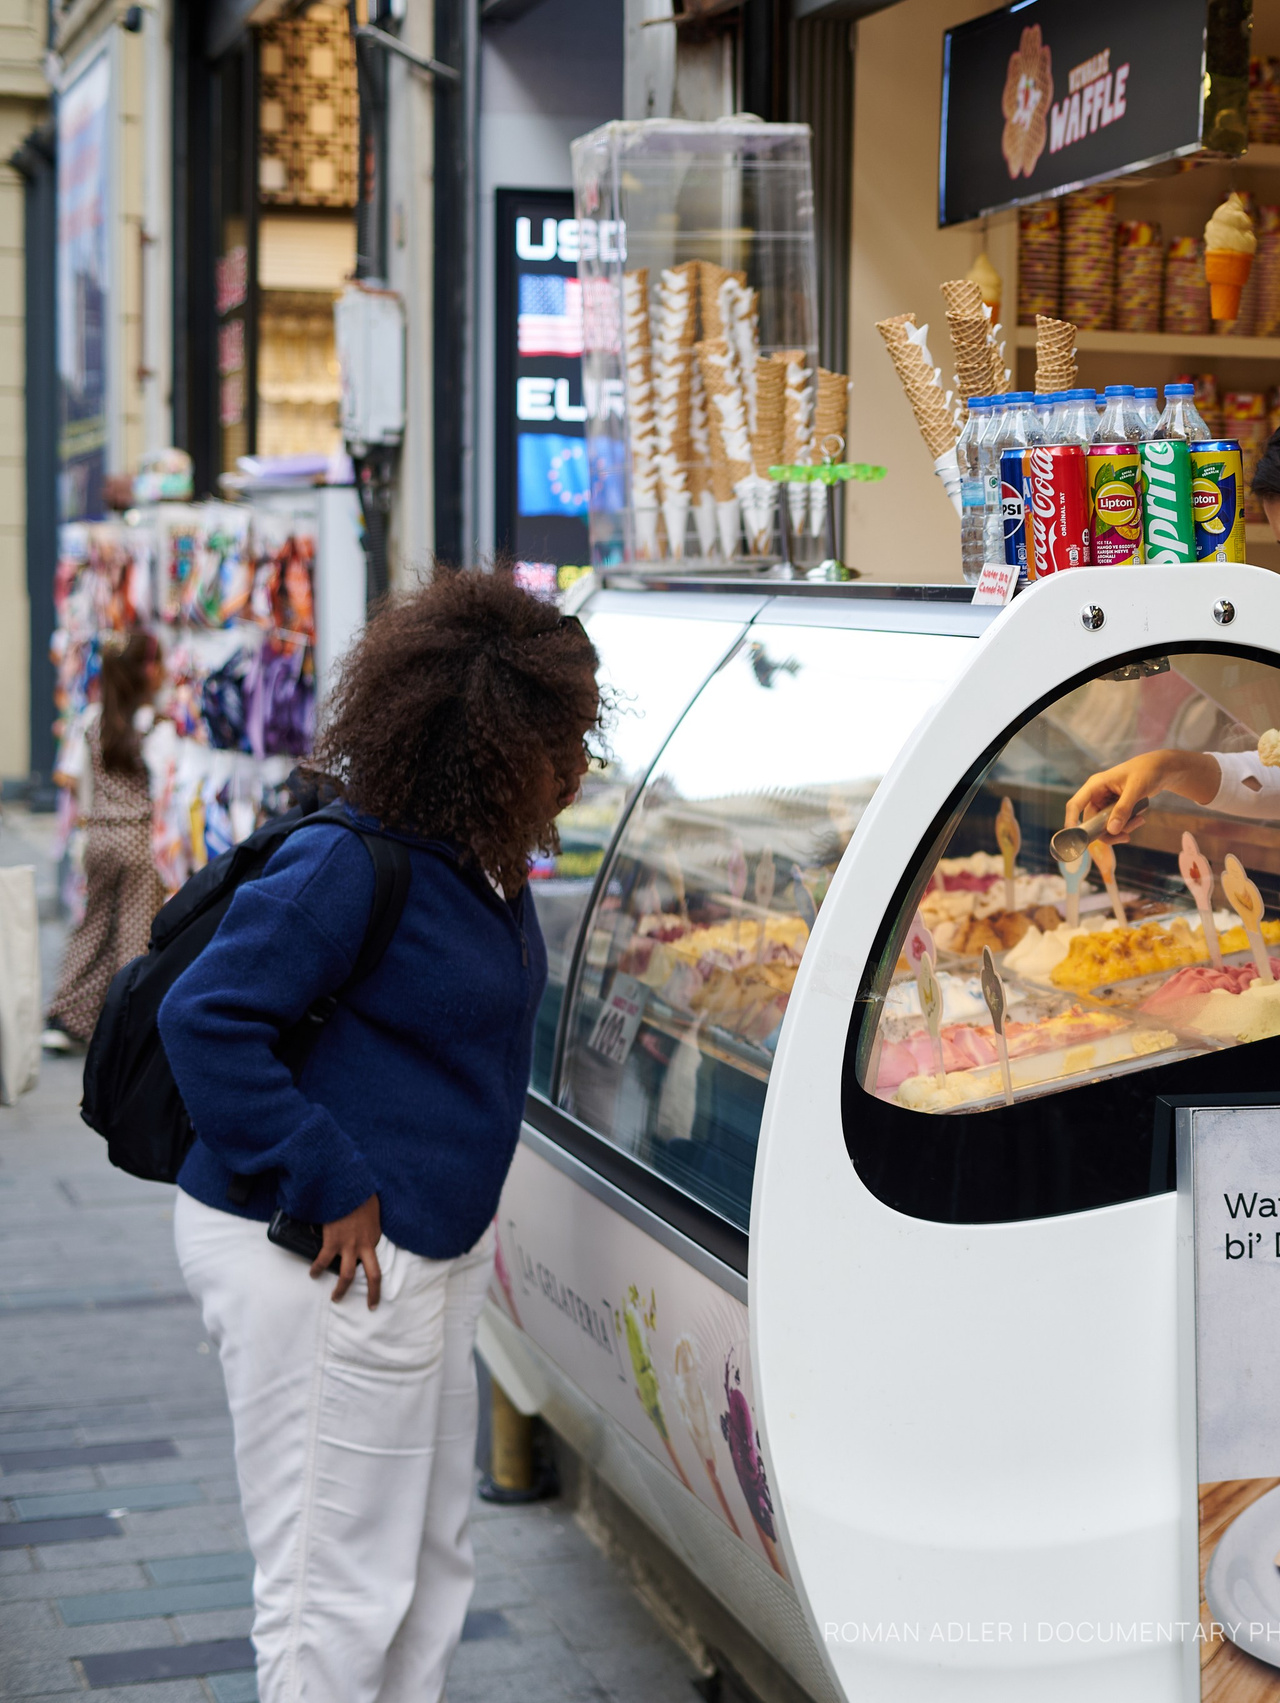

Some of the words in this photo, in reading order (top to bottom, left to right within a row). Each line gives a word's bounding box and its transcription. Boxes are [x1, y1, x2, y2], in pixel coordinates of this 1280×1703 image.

[1049, 62, 1130, 154] WAFFLE
[1100, 498, 1133, 509] Lipton
[1194, 495, 1216, 506] pton
[1002, 503, 1022, 516] PSI
